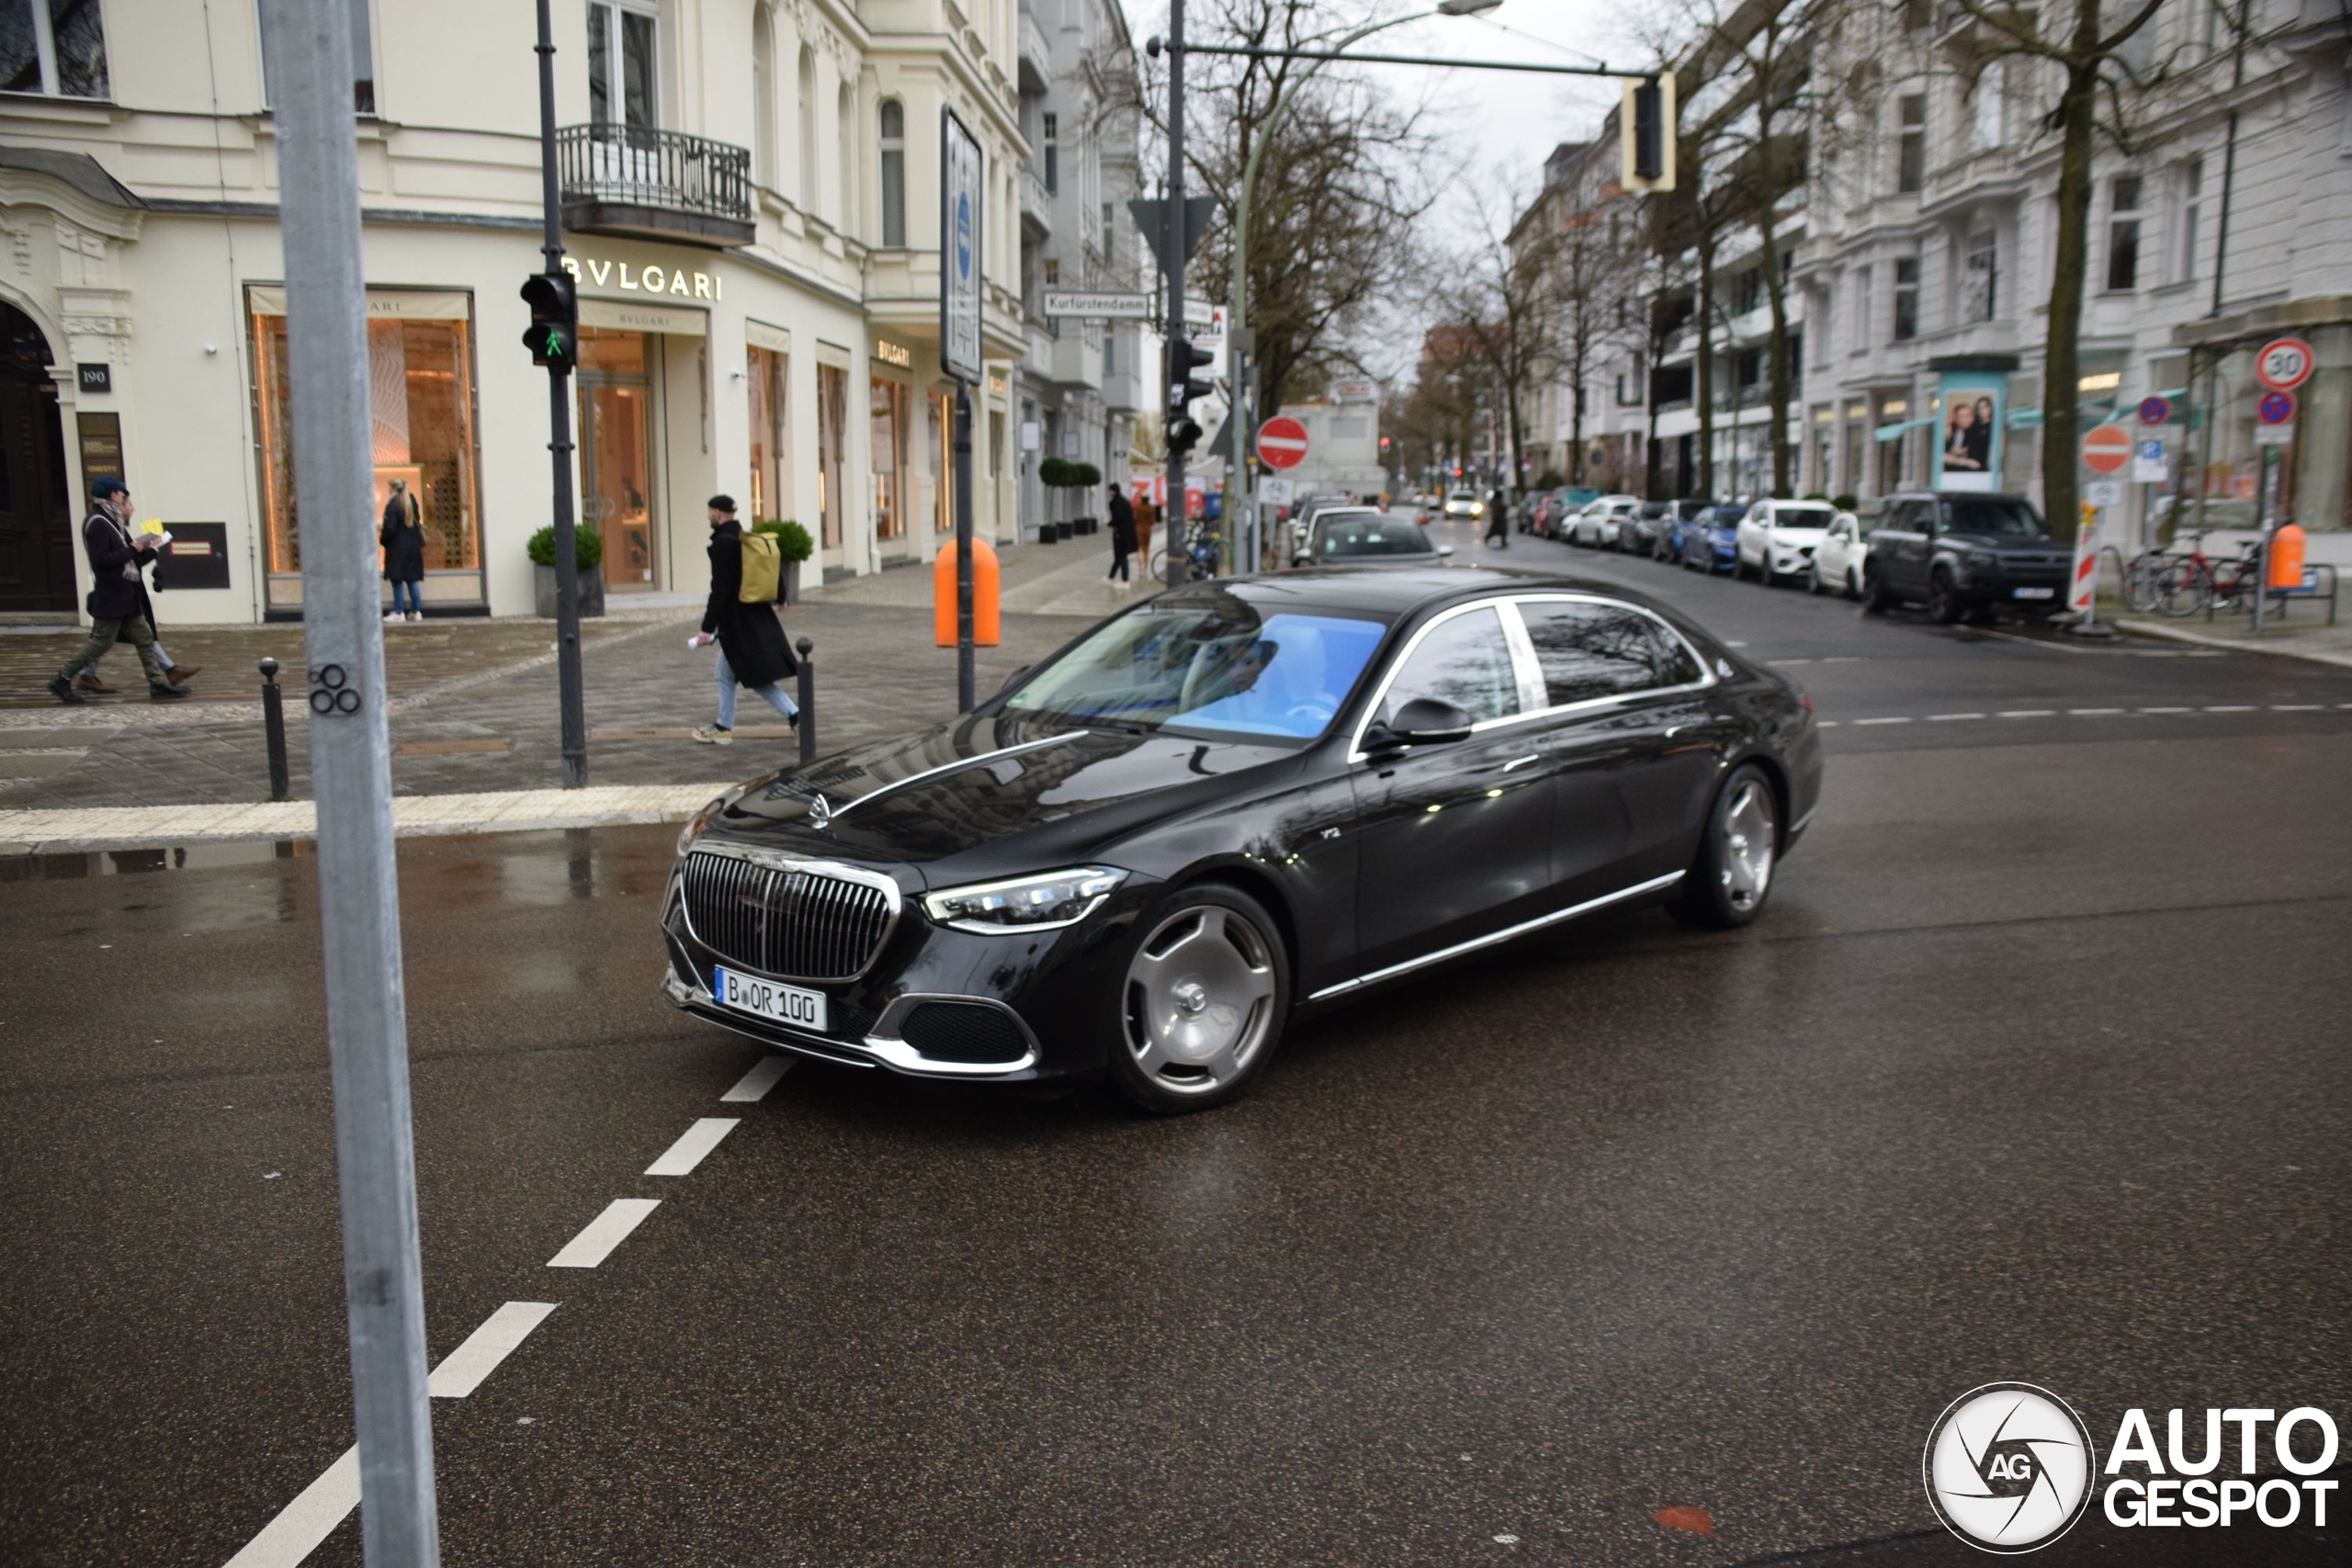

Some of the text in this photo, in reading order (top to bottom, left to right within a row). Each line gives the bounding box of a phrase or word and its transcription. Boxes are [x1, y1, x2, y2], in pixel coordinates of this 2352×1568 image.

[560, 257, 722, 301] BVLGARI
[1048, 296, 1146, 310] Kurfürstendamm
[2268, 354, 2301, 376] 30
[83, 370, 106, 384] 190
[729, 976, 815, 1023] B OR 100
